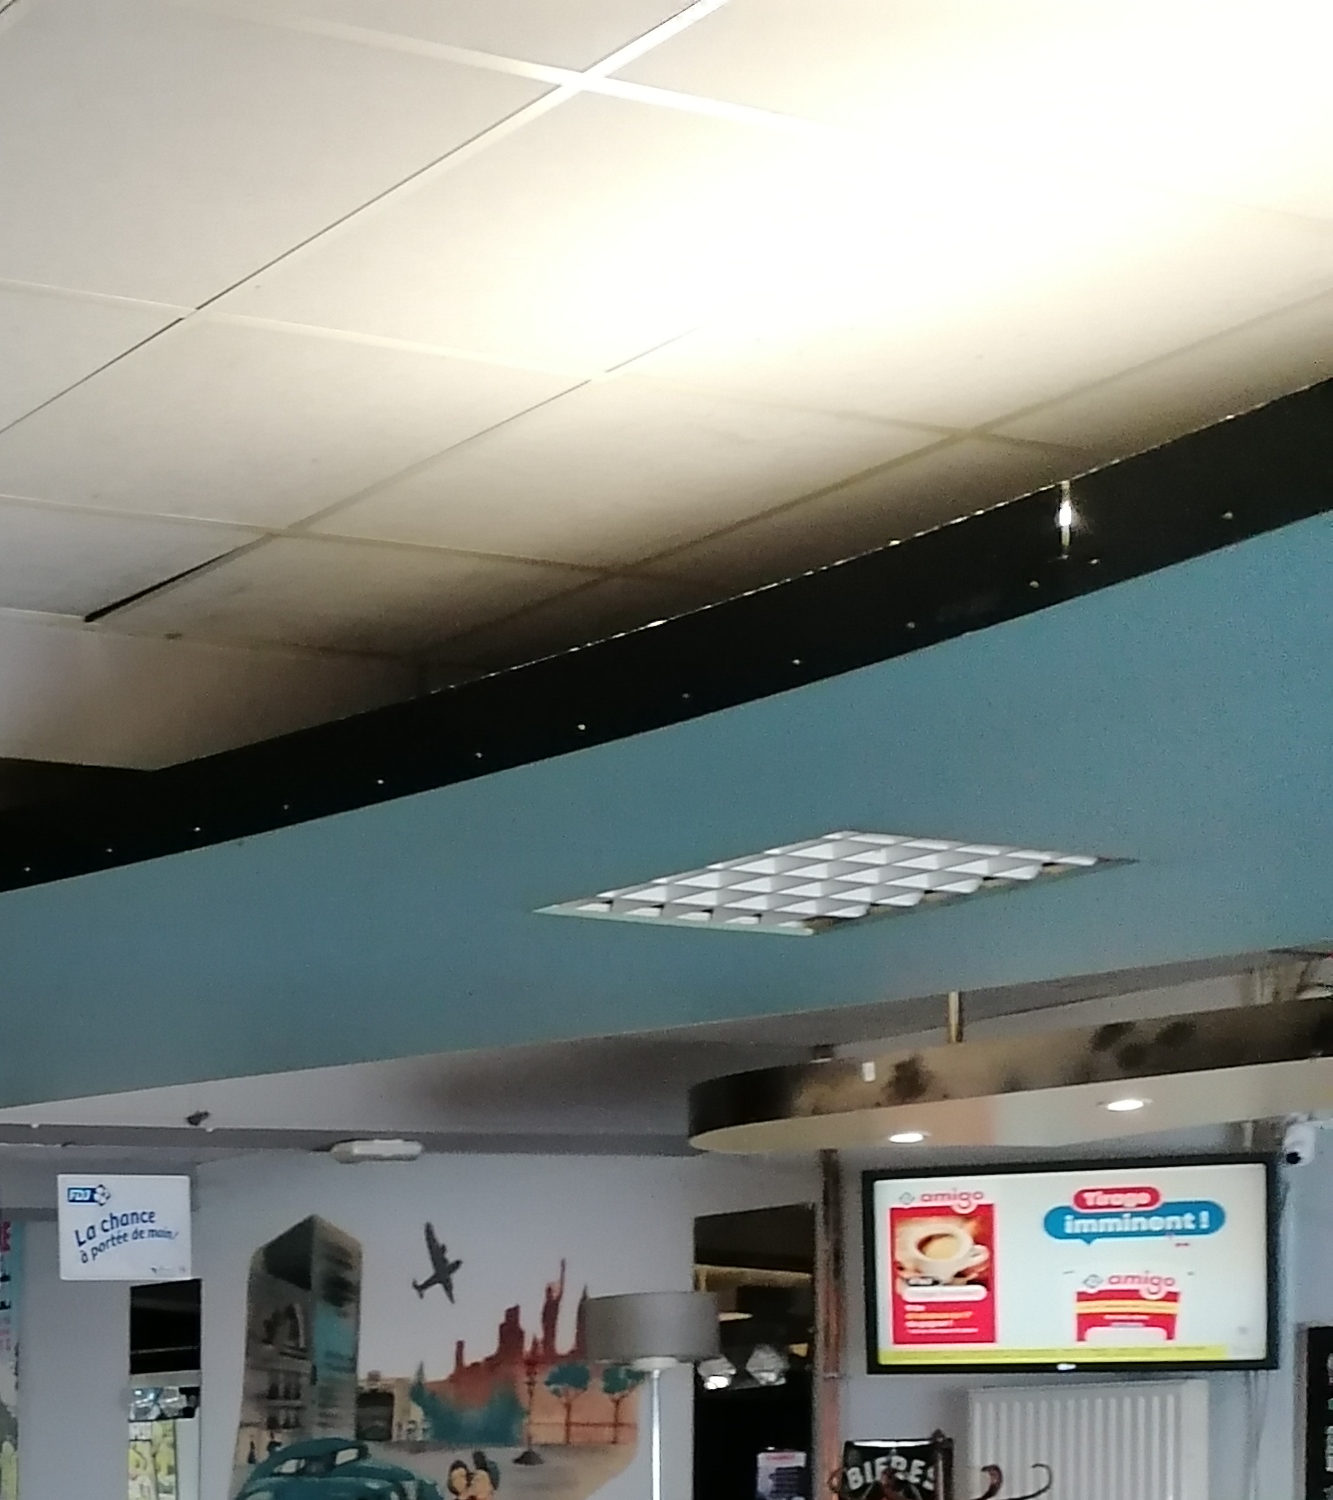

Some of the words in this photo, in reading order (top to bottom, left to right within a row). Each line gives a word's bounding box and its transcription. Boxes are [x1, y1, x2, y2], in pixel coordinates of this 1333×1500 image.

[75, 1225, 96, 1248] La
[100, 1211, 156, 1233] chance
[1063, 1212, 1196, 1234] imminent
[90, 1229, 129, 1262] portée
[131, 1226, 146, 1241] de
